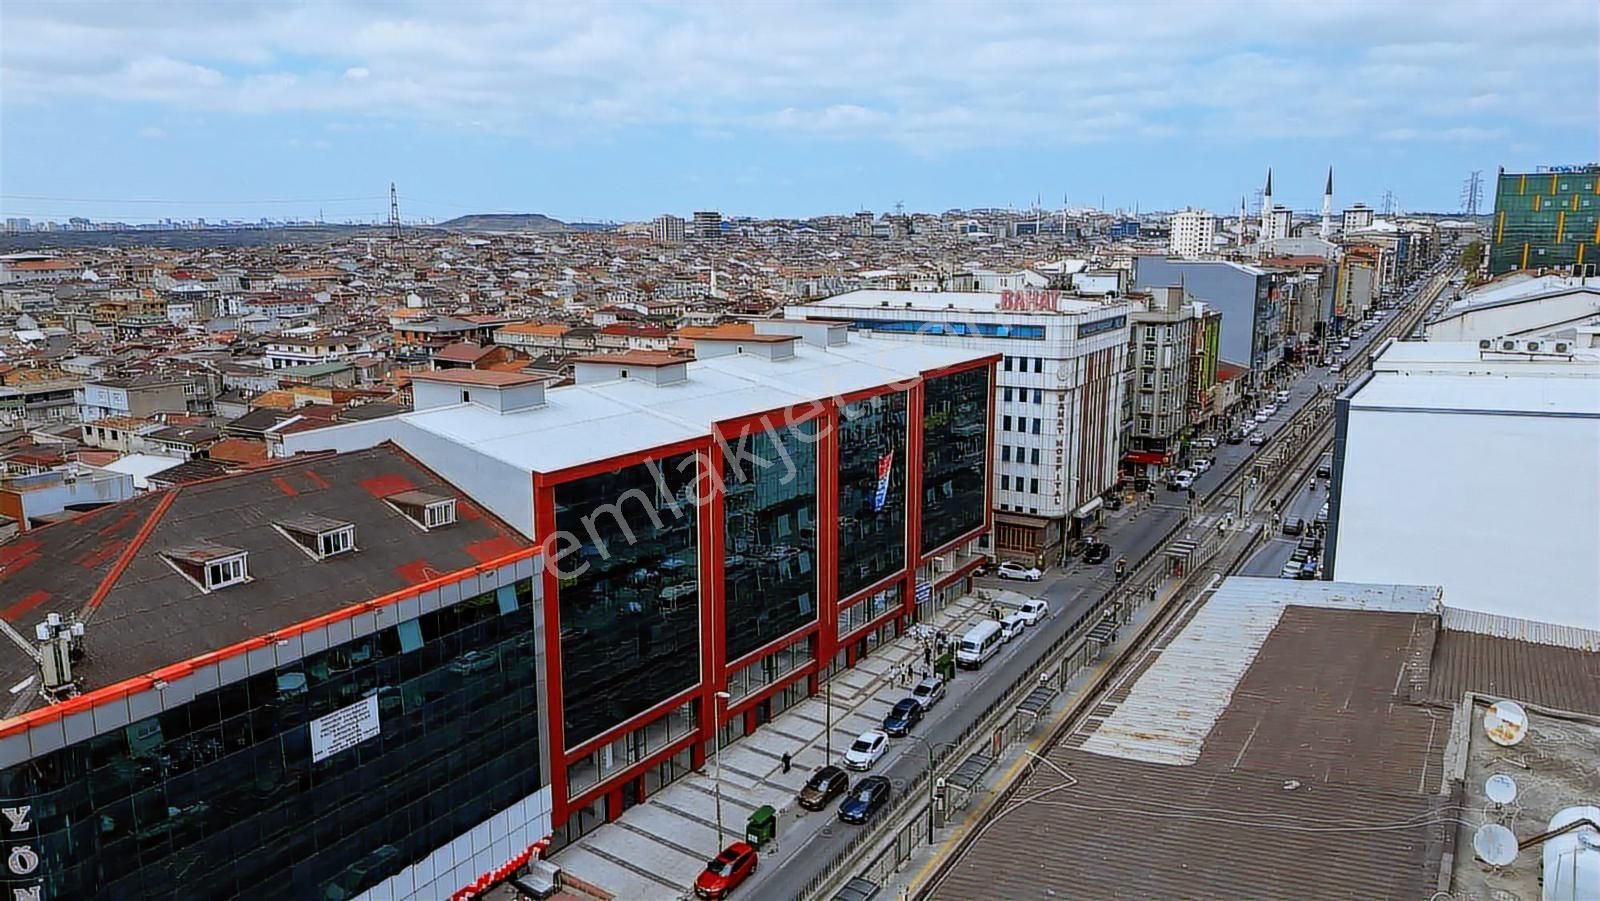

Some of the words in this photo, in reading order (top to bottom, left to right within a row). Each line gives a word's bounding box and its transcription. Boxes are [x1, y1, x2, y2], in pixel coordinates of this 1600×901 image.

[1001, 289, 1060, 312] BAHAT
[1056, 394, 1066, 434] BAHAT
[1054, 440, 1065, 505] HOSPITAL
